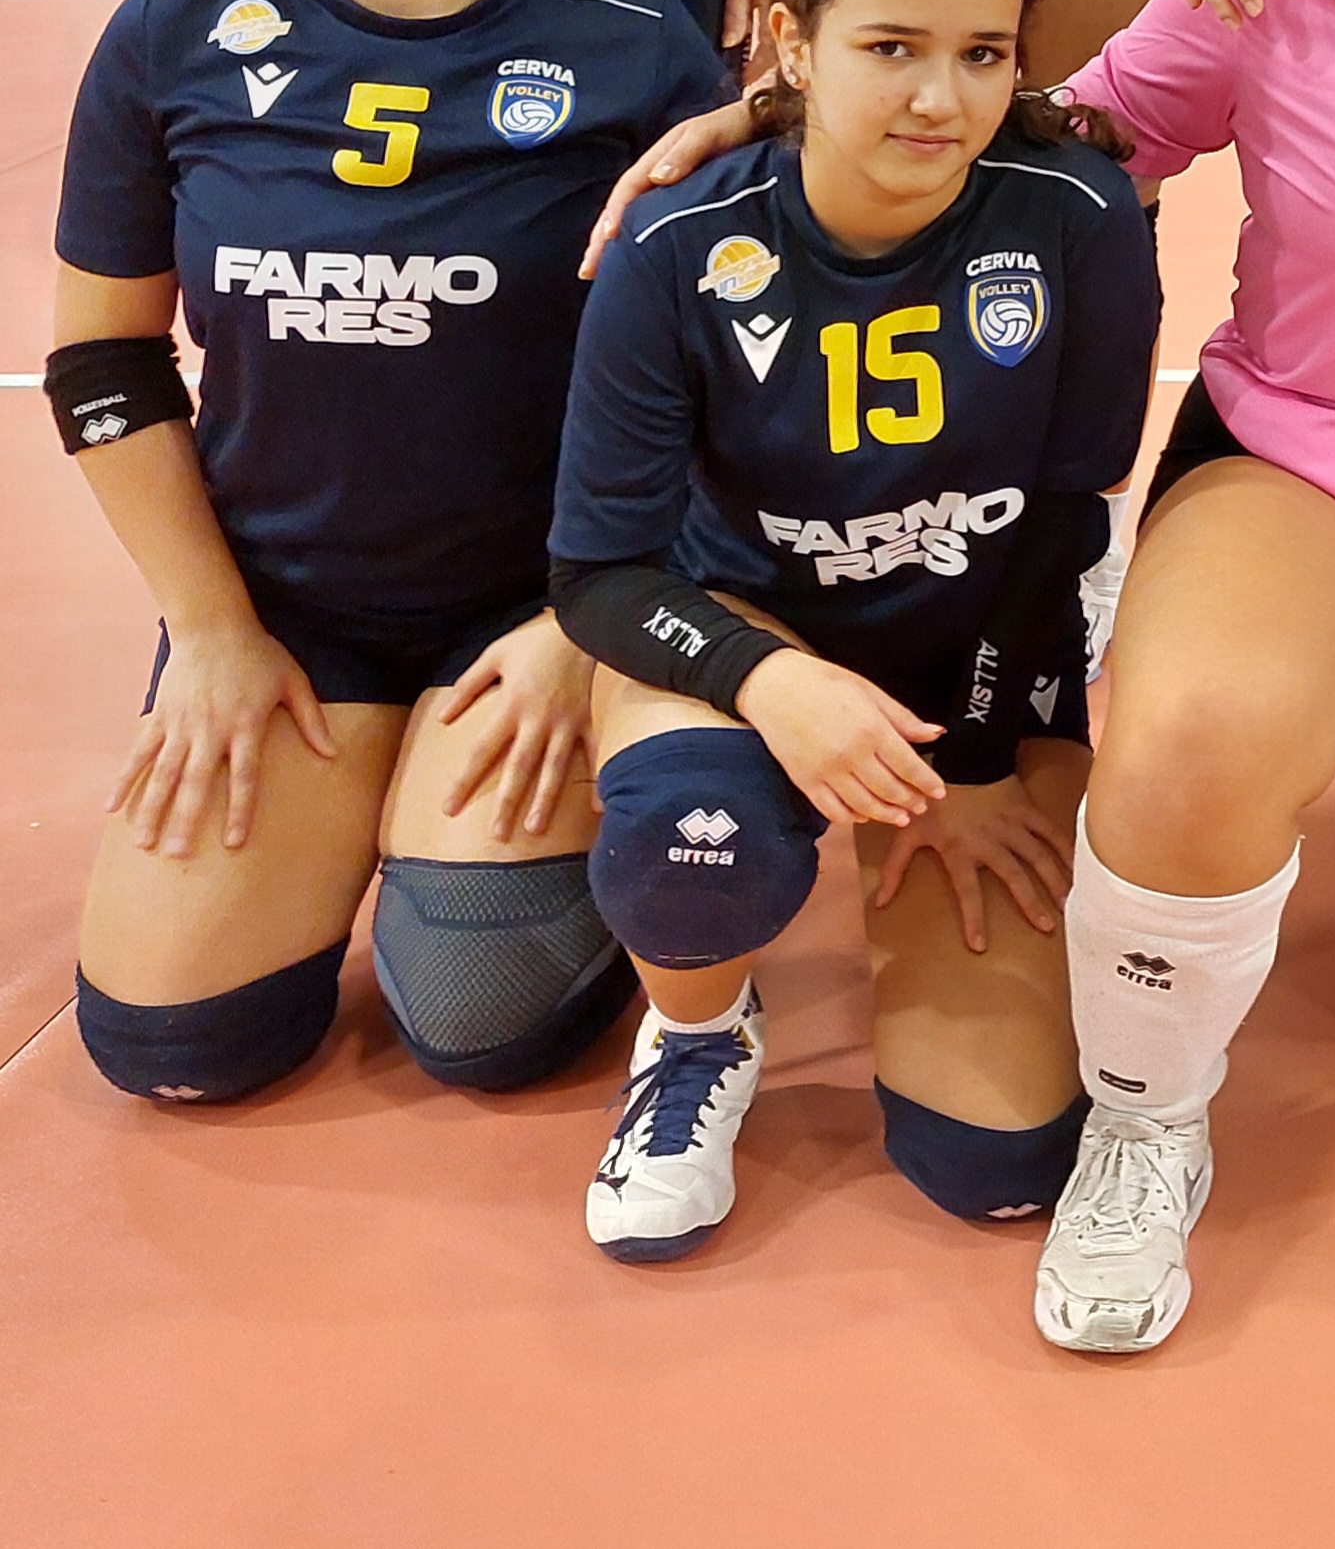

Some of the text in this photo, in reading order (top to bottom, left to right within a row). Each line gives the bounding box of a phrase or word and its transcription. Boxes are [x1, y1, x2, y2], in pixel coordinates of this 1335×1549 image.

[498, 59, 576, 88] CERVIA
[506, 85, 562, 103] VOLLEY
[332, 82, 430, 187] 5
[214, 245, 498, 305] FARMO
[965, 252, 1042, 277] CERVIA
[978, 282, 1031, 299] VOLLEY
[267, 297, 432, 347] RES
[820, 305, 945, 454] 15
[757, 486, 1025, 555] FARMO
[814, 527, 969, 586] RES
[965, 638, 999, 723] ALLSIX
[667, 845, 735, 866] errea
[1117, 963, 1173, 991] errea
